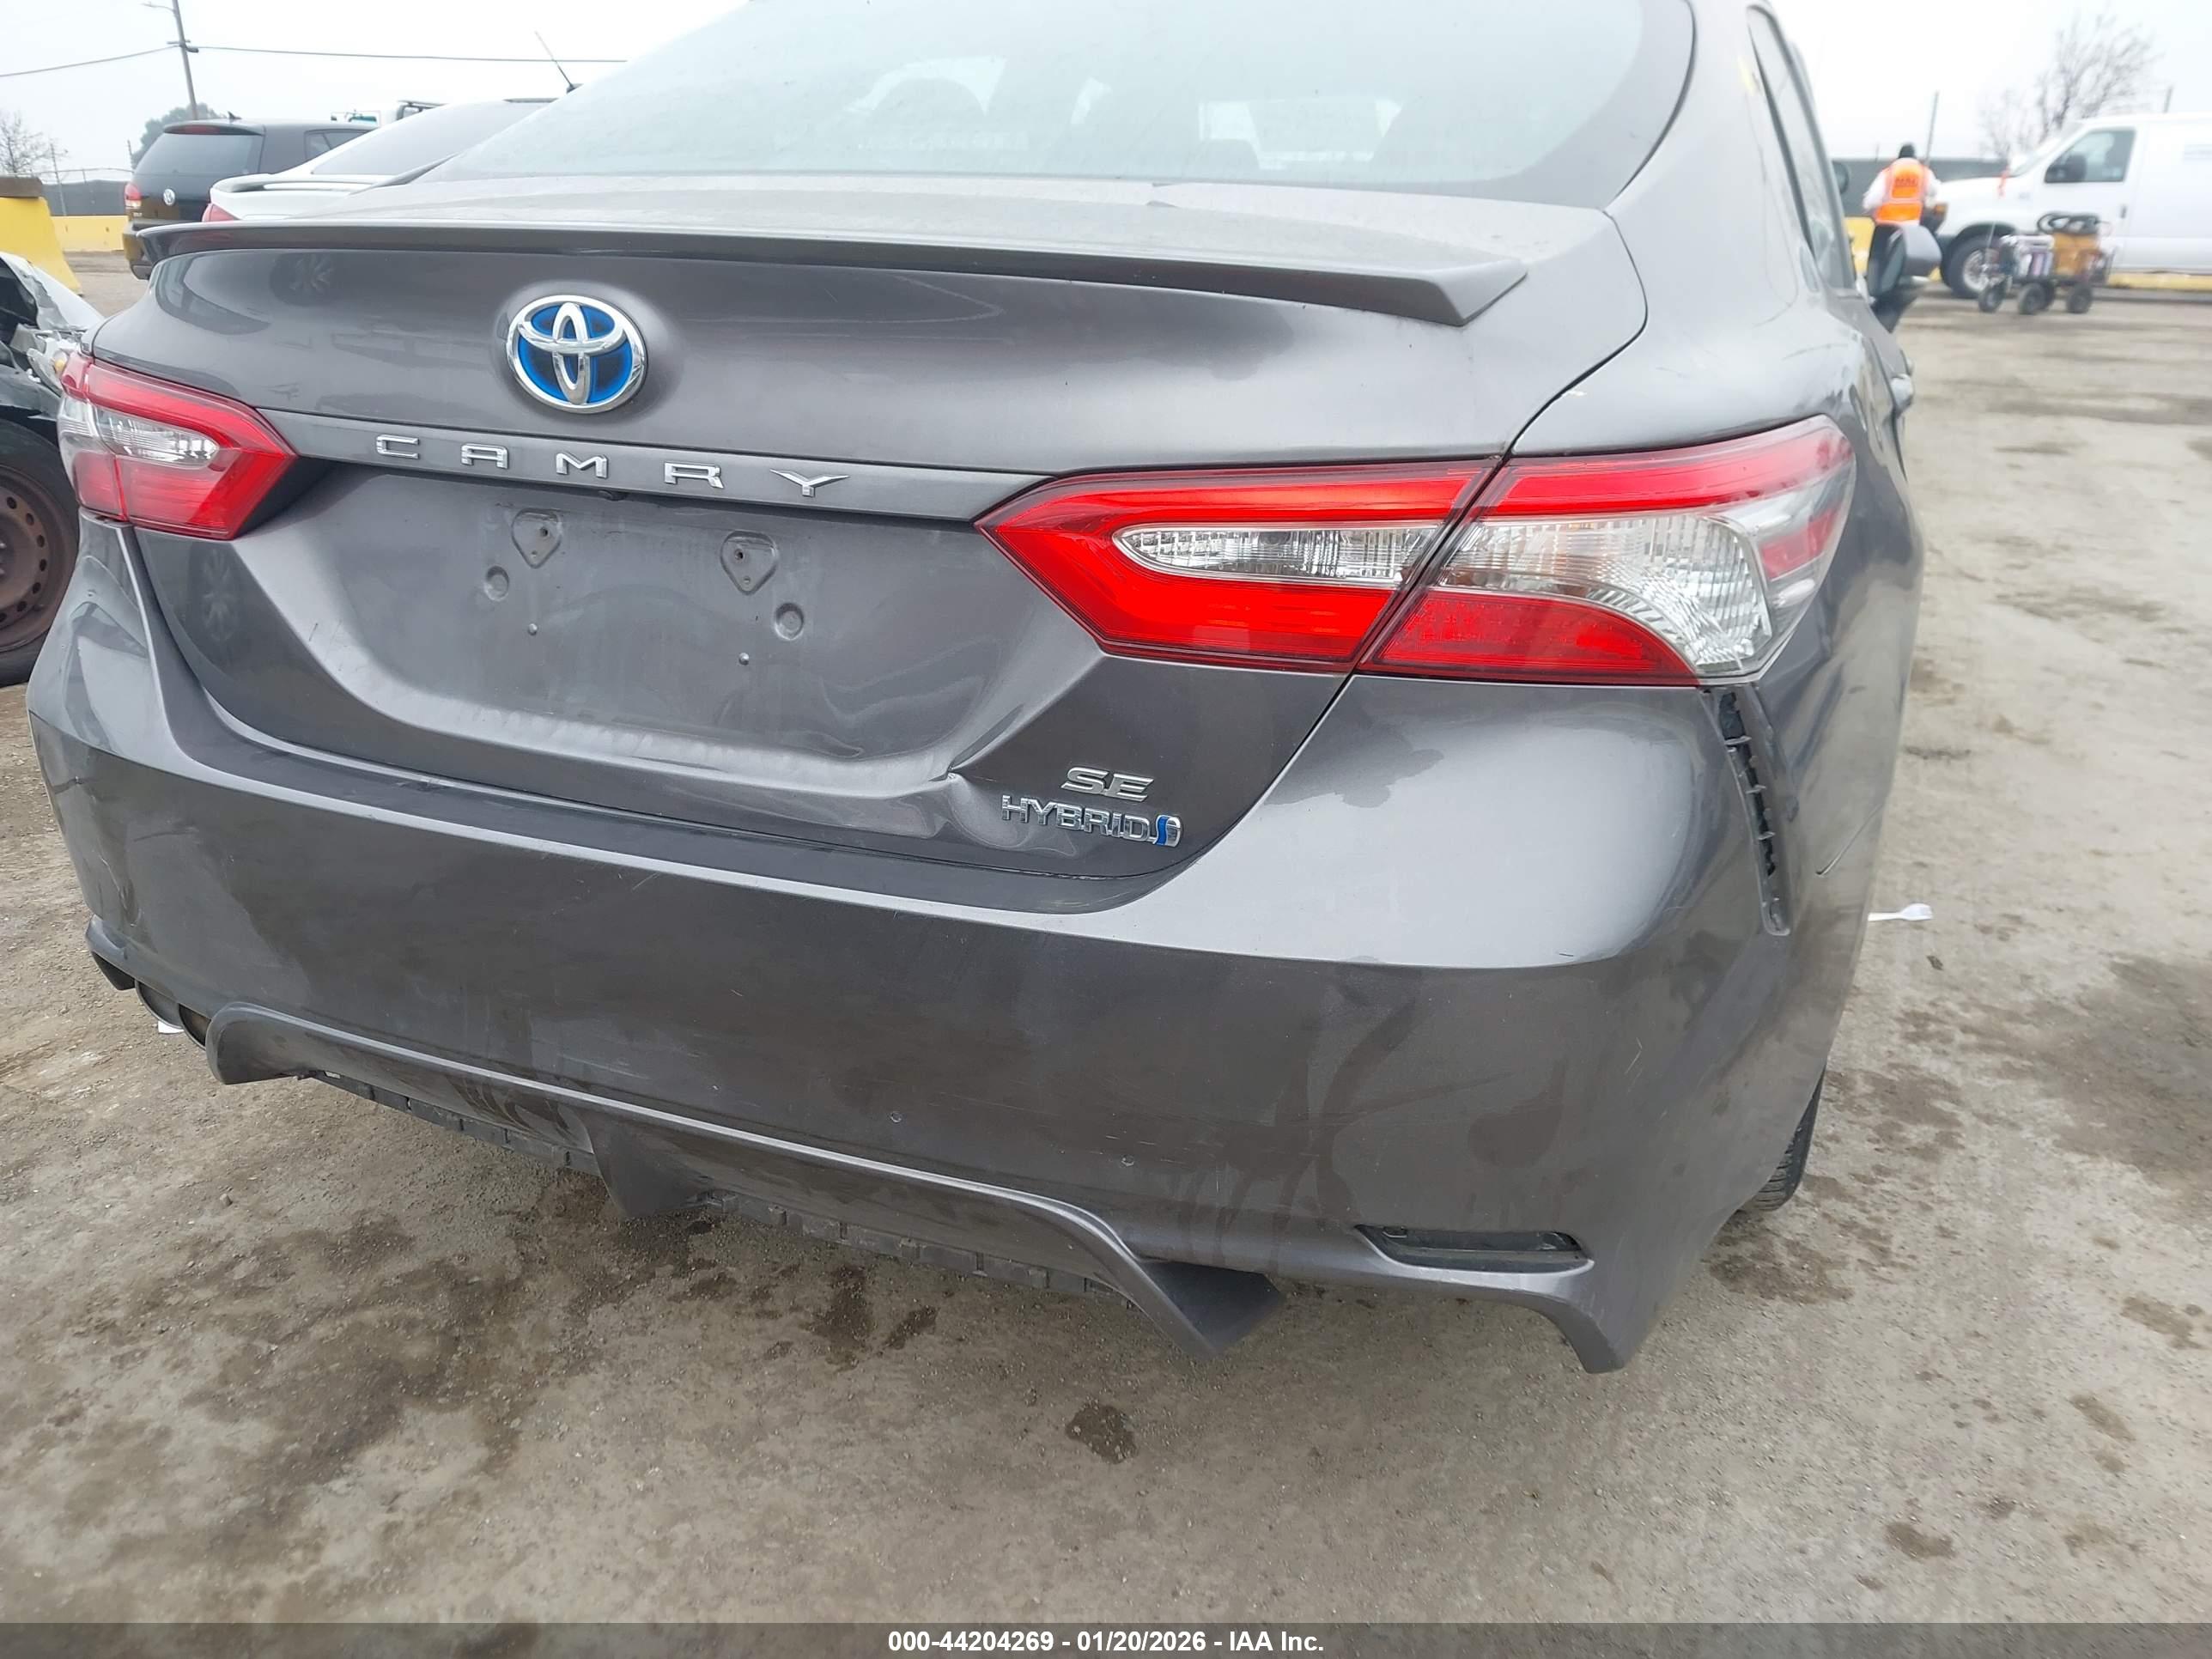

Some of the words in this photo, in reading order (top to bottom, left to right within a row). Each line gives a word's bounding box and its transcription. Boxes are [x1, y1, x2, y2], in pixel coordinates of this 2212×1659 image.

[375, 434, 849, 497] CAMRY
[1060, 766, 1154, 802] SE
[1001, 794, 1151, 842] HYBRID
